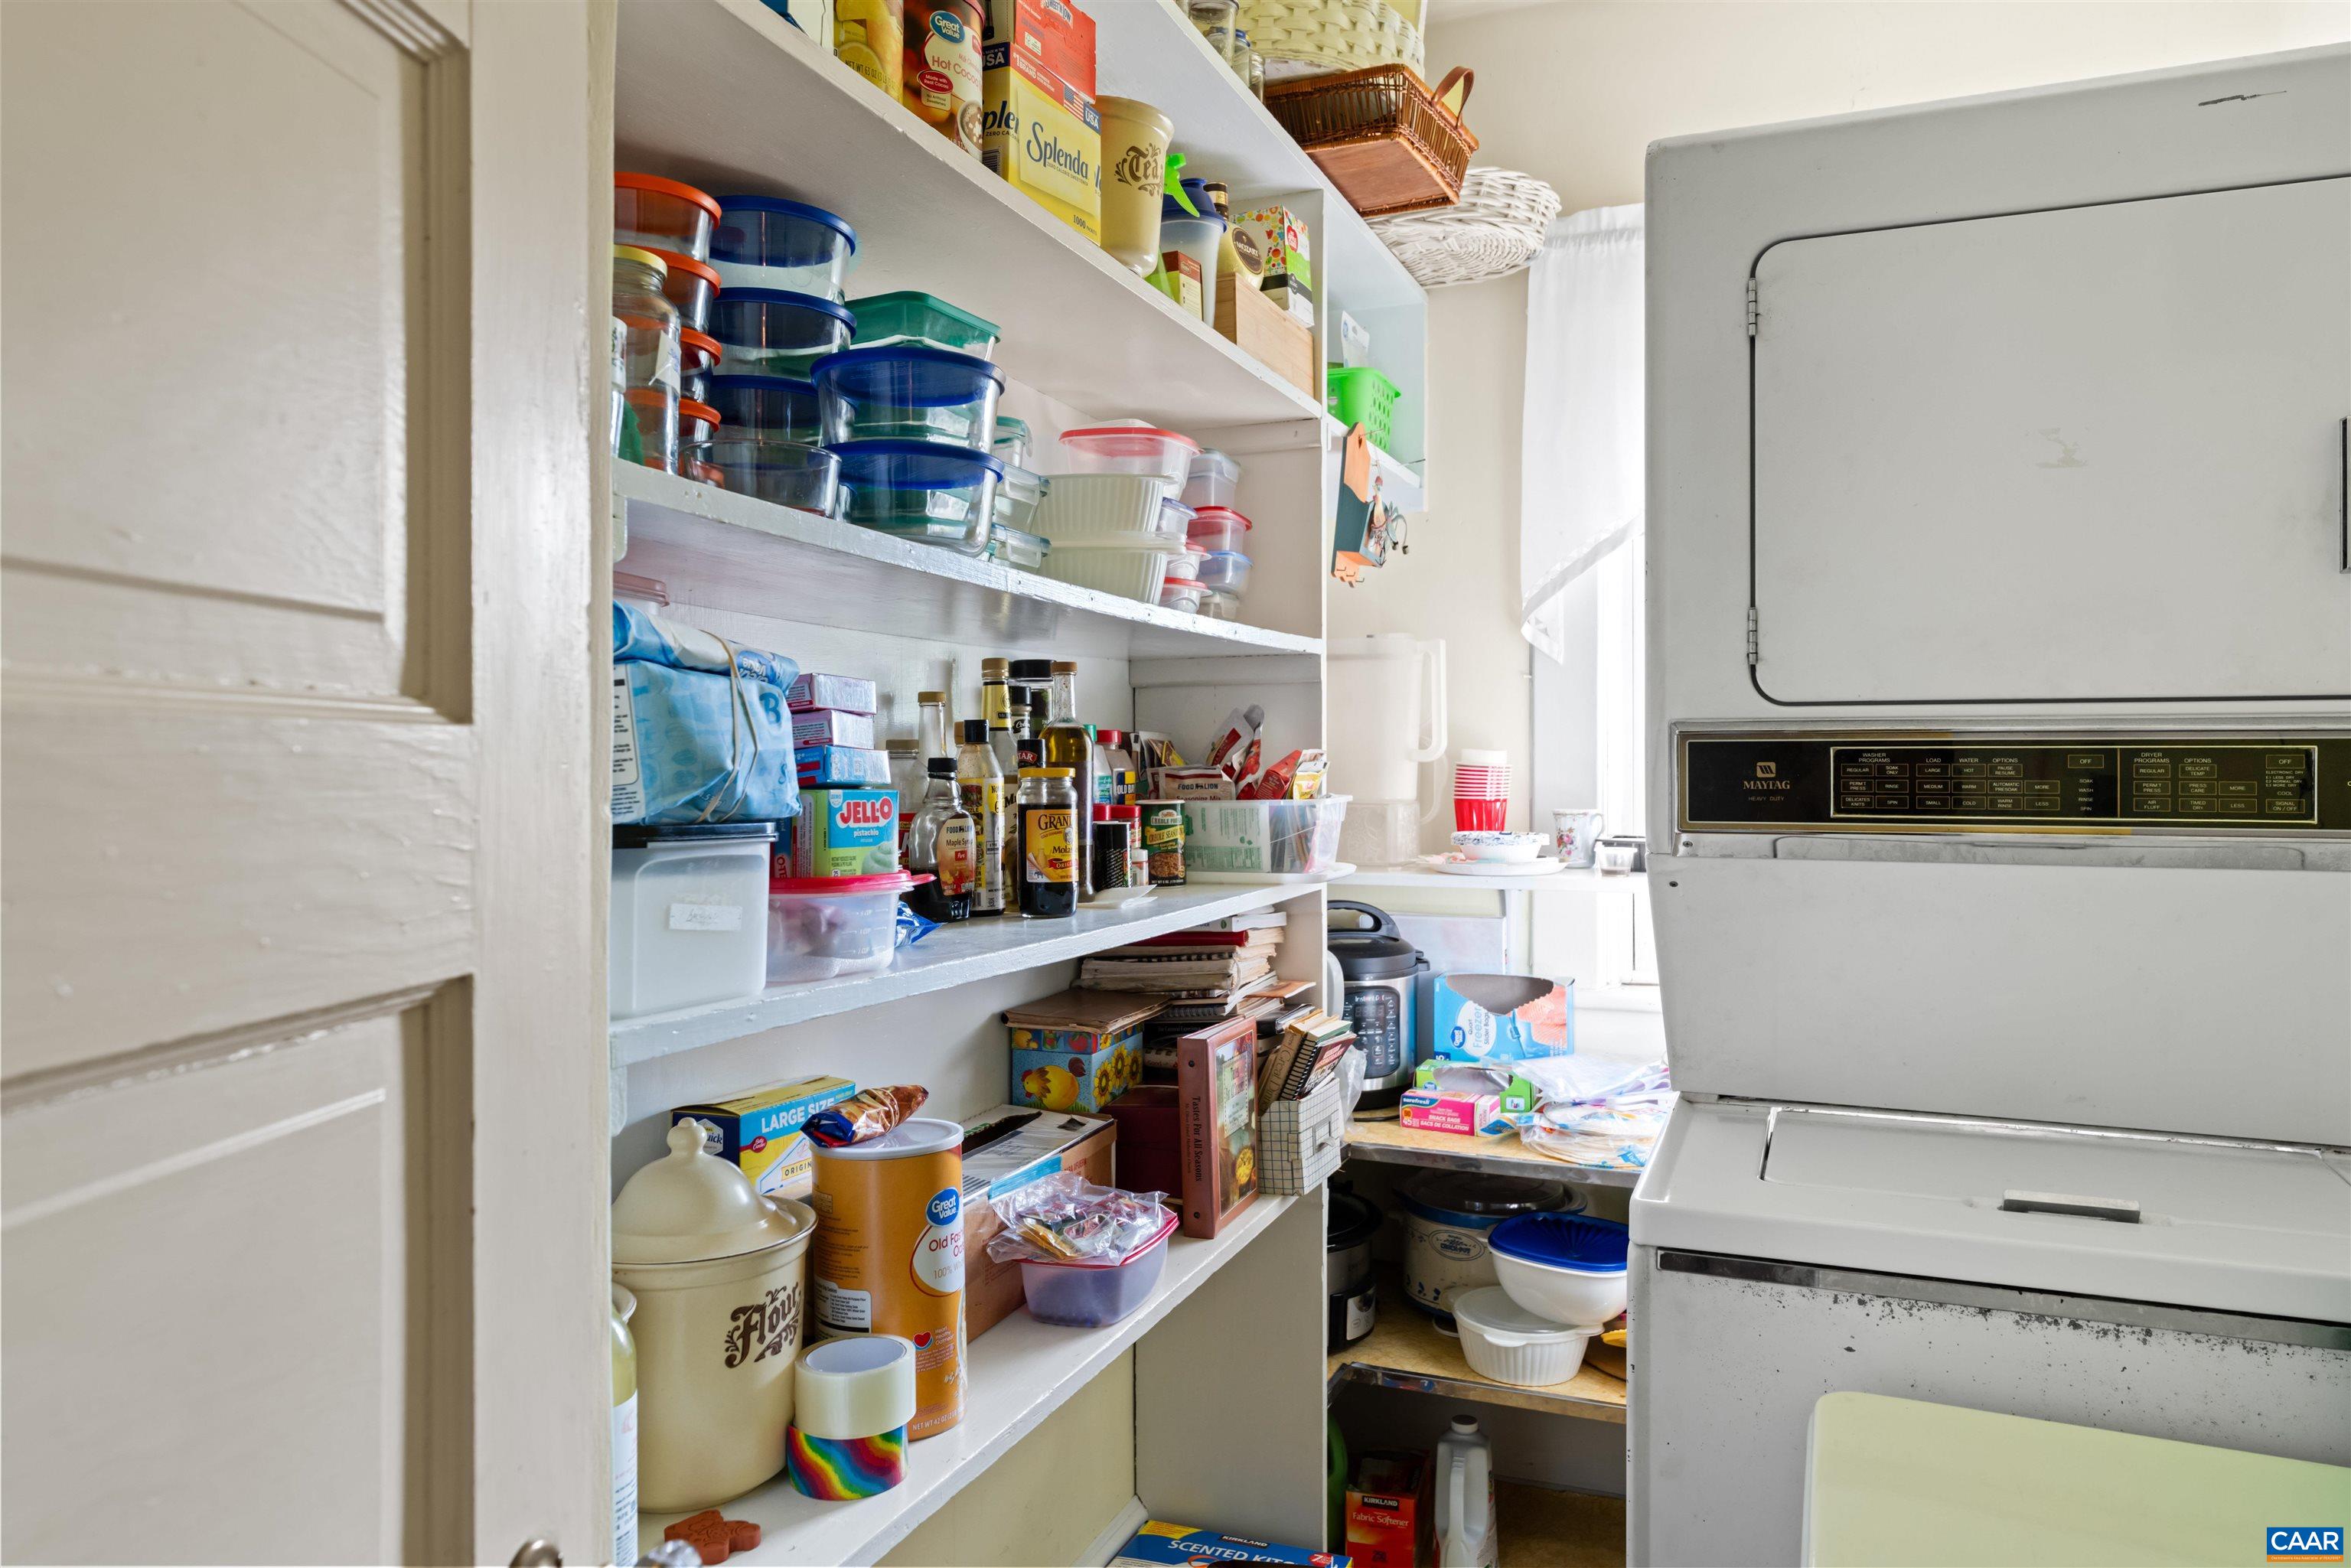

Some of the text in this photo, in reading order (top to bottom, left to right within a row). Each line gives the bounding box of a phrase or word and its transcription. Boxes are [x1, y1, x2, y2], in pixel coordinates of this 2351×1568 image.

[934, 15, 960, 33] Great
[941, 25, 960, 39] Value
[856, 63, 863, 74] WT
[865, 66, 871, 76] 63
[872, 68, 878, 79] OZ
[925, 73, 938, 82] Made
[932, 55, 979, 87] Hot Cocoa
[934, 81, 949, 90] Cocoa
[1085, 110, 1099, 129] USA
[1026, 121, 1088, 181] Splenda
[1046, 161, 1056, 170] ZERO
[1126, 145, 1159, 183] Tea
[1073, 214, 1086, 229] 1000
[1236, 240, 1259, 257] MOZART
[1117, 784, 1127, 794] OLD
[1743, 781, 1790, 790] MAYTAG
[840, 797, 892, 824] JELL-O
[1038, 813, 1072, 831] GRAN
[853, 828, 879, 839] pistachio
[946, 838, 961, 847] Maple
[1473, 1007, 1482, 1048] Freezer
[761, 1097, 836, 1133] LARGE SIZE
[1192, 1096, 1201, 1122] Tastes
[1428, 1114, 1446, 1123] SNACK
[1193, 1123, 1202, 1137] For
[1442, 1123, 1469, 1132] COLLATION
[1194, 1138, 1202, 1149] All
[784, 1161, 812, 1176] ORIGIN
[931, 1194, 957, 1214] Great
[938, 1207, 957, 1219] Value
[928, 1229, 964, 1252] Old Fas
[934, 1265, 953, 1280] 100%
[725, 1282, 798, 1368] Flour
[934, 1325, 947, 1334] Heart
[935, 1331, 951, 1341] Healthy
[912, 1422, 924, 1431] NET
[924, 1419, 934, 1429] WT
[941, 1414, 948, 1423] OZ
[1364, 1497, 1398, 1507] KIRKLAND
[1352, 1511, 1409, 1527] Fabric Softener
[1221, 1535, 1268, 1547] KIRKLAND
[1168, 1540, 1248, 1561] SCENTED
